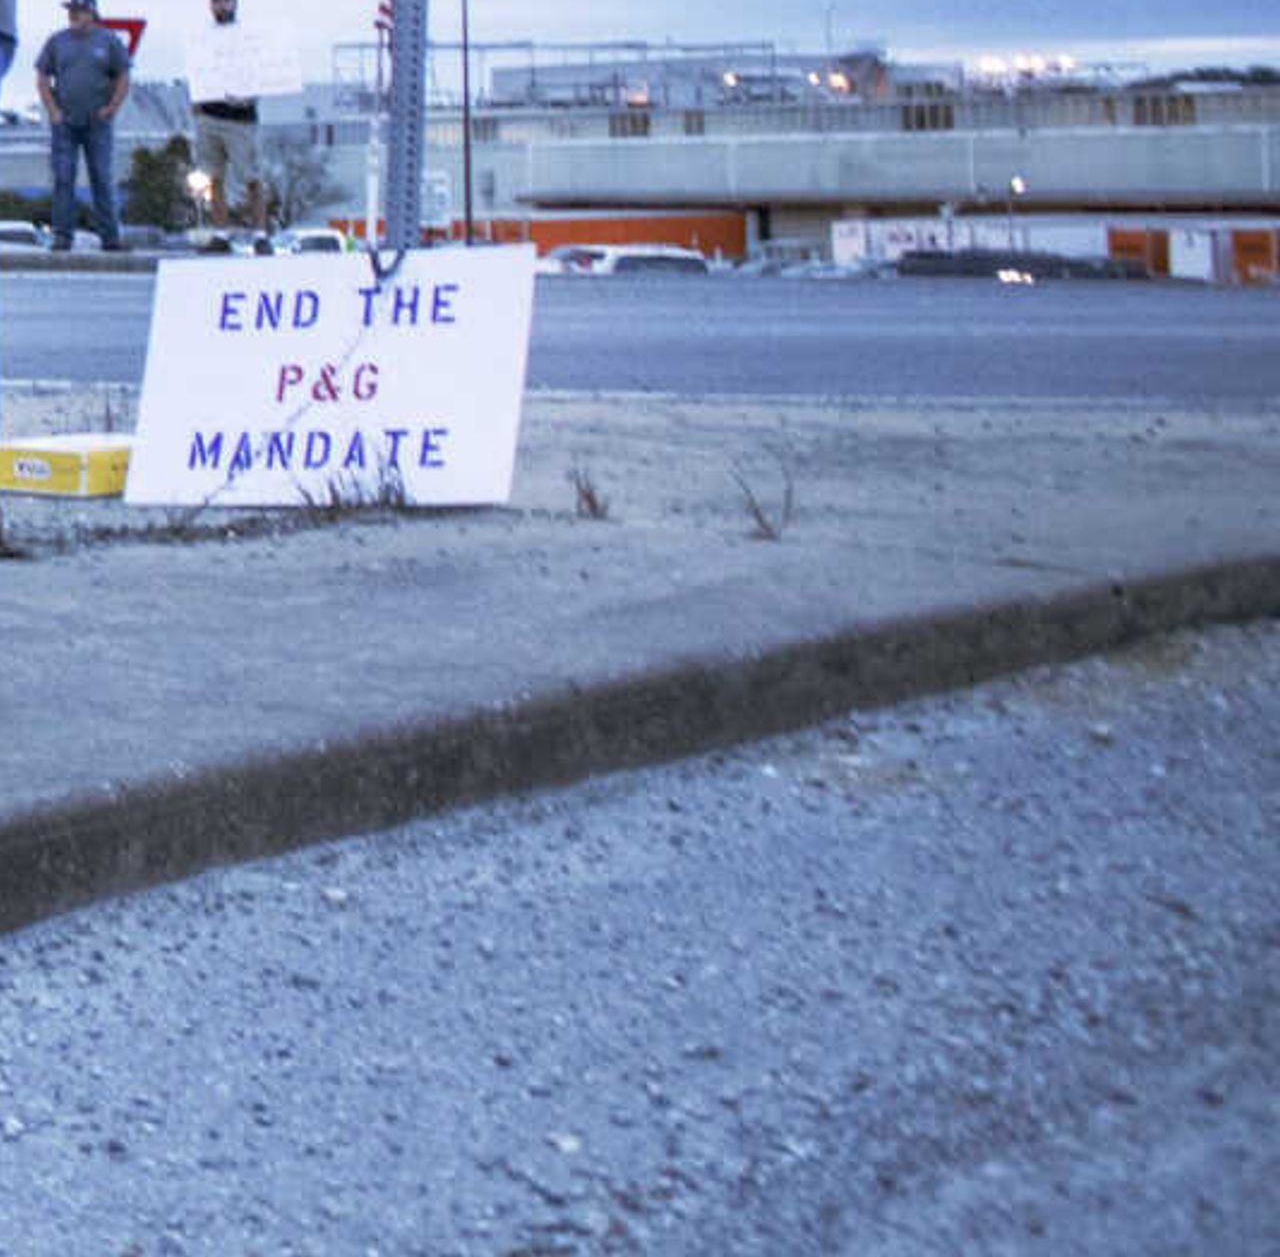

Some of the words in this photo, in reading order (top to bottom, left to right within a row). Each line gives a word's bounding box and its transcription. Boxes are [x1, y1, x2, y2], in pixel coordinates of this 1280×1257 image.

[218, 289, 320, 331] END
[357, 283, 460, 328] THE
[275, 362, 380, 403] P&G
[187, 427, 449, 472] MANDATE
